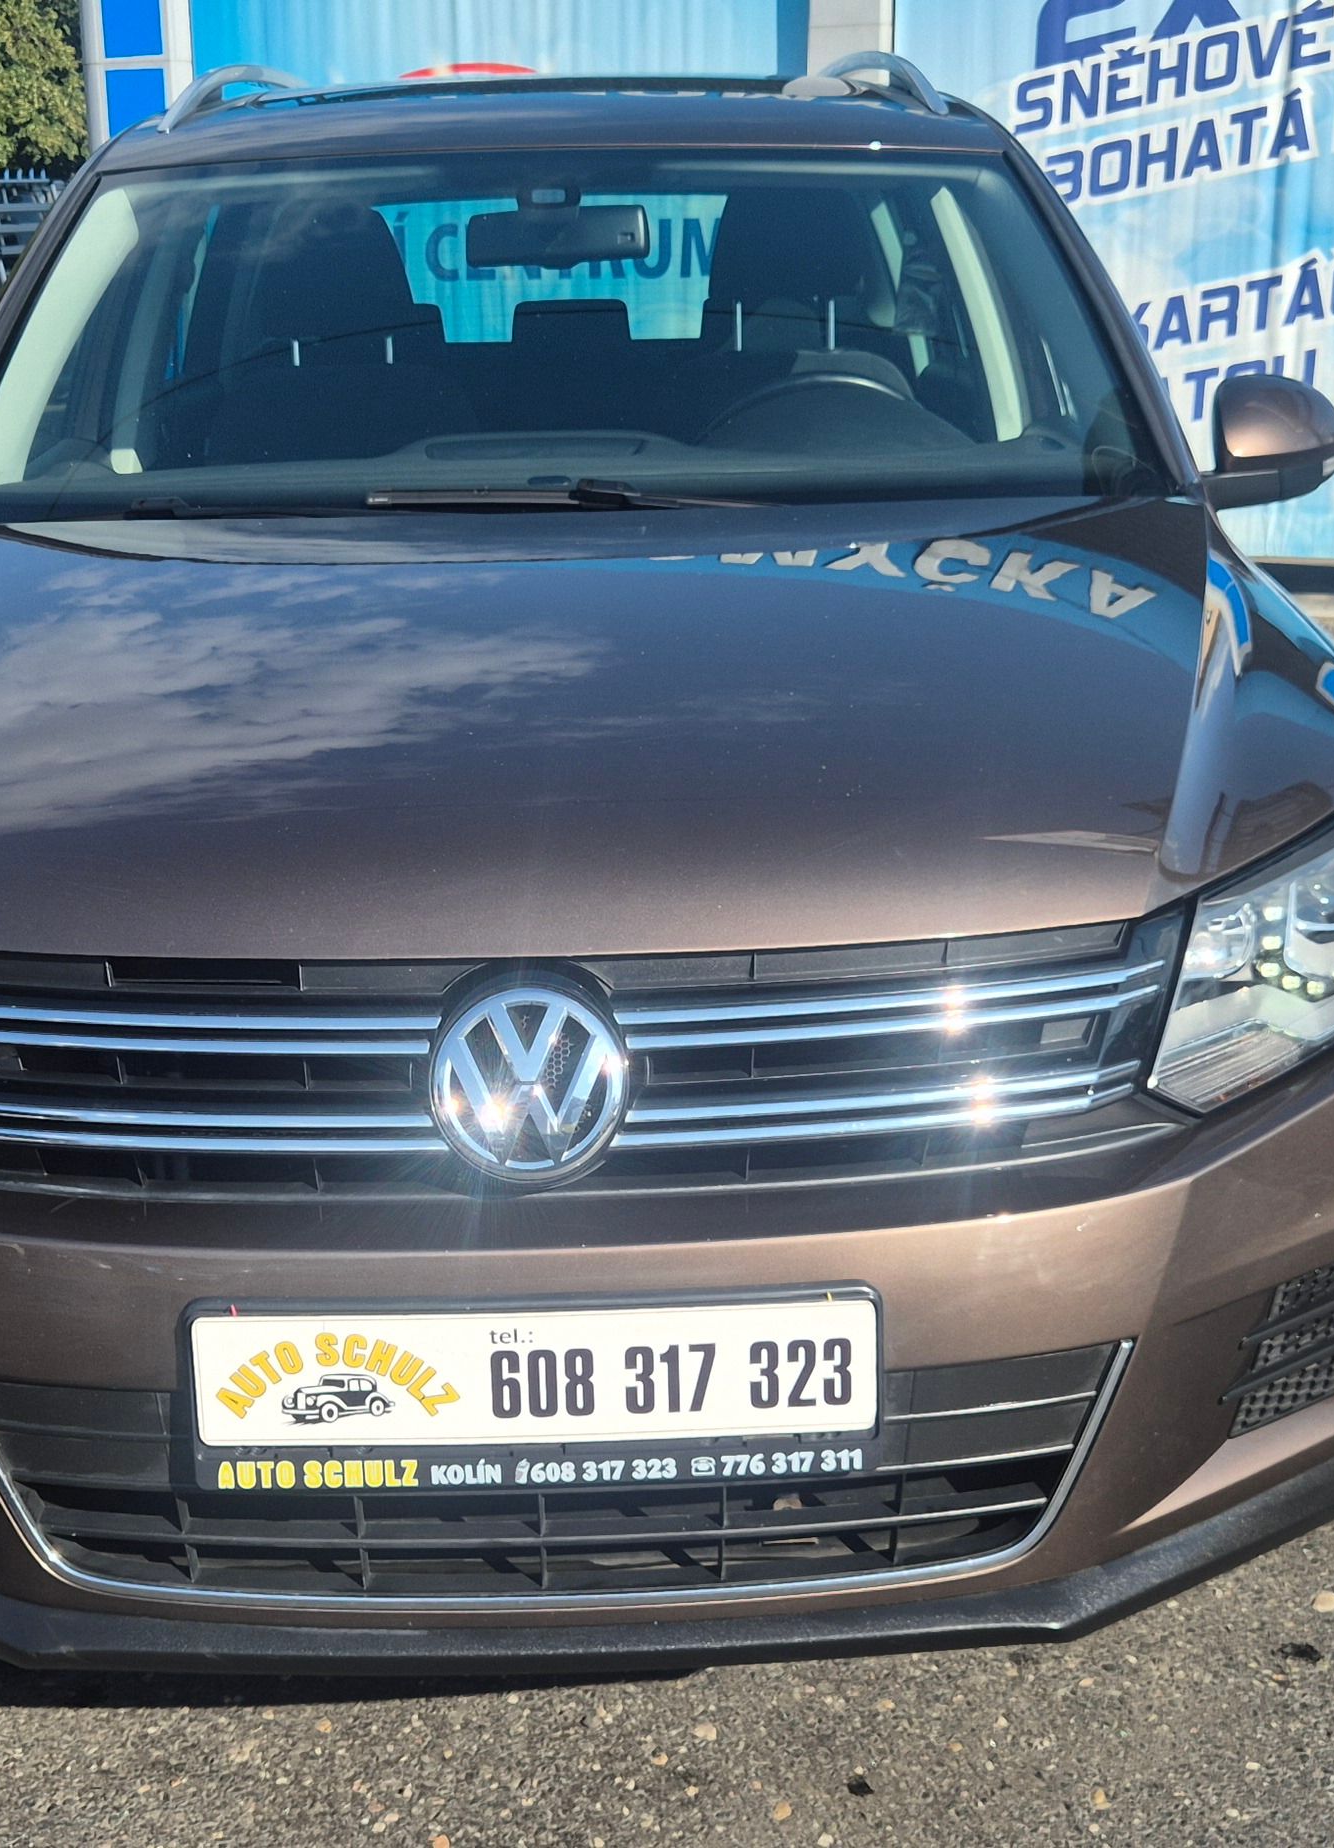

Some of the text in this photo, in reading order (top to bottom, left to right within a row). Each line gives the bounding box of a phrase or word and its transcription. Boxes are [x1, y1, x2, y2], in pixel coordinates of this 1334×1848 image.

[1013, 0, 1334, 134] SNĚHOVÉ
[1045, 88, 1311, 204] BOHATÁ
[216, 1332, 461, 1419] AUTO SCHULZ
[489, 1329, 534, 1345] tel.:
[490, 1337, 853, 1419] 608 317 323
[218, 1448, 863, 1490] AUTO SCHULZ KOLÍN 608 317 323 776 317 311
